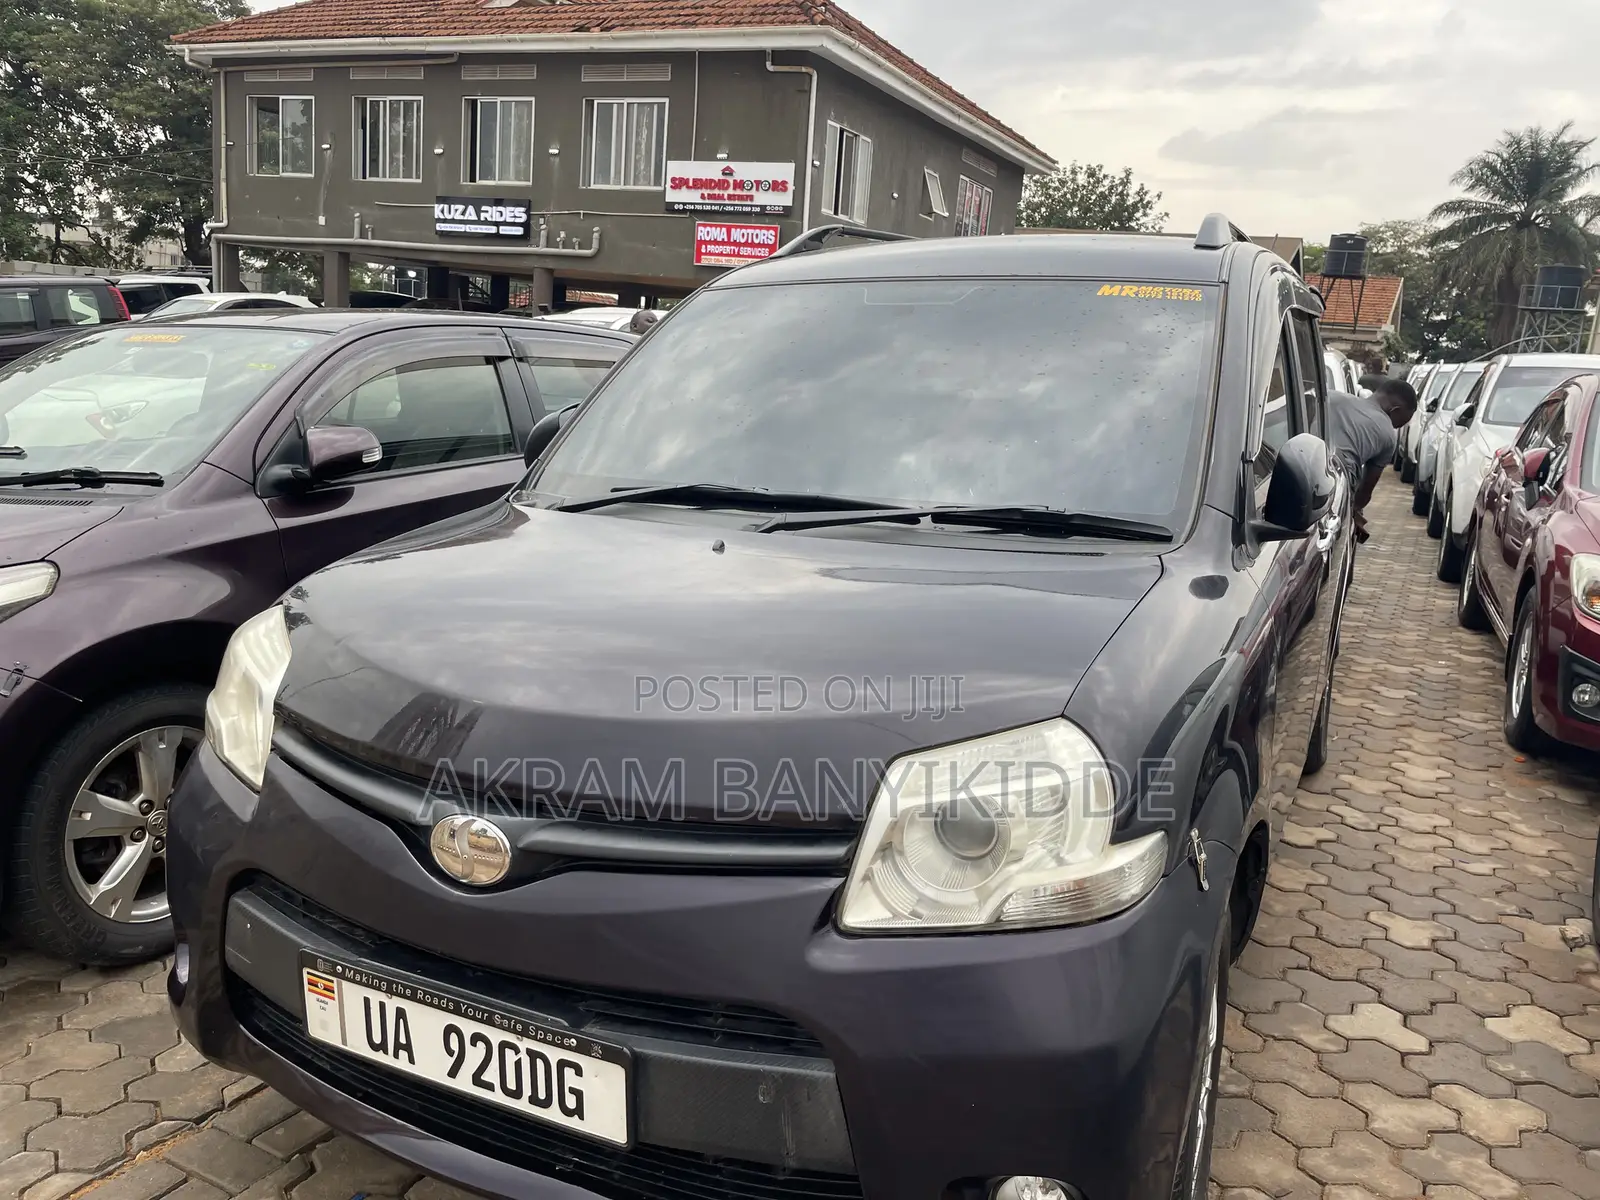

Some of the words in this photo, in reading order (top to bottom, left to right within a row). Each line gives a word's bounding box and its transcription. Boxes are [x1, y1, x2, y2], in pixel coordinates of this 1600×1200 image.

[670, 177, 730, 191] SPLENDID
[733, 179, 788, 193] MOTORS
[434, 203, 478, 220] KUZA
[480, 205, 528, 223] RIDES
[697, 226, 728, 242] ROMA
[730, 228, 775, 244] MOTORS
[701, 245, 706, 253] &
[706, 245, 739, 255] PROPERTY
[740, 247, 769, 256] SERVICES
[345, 968, 387, 992] Making
[392, 983, 412, 997] the
[417, 989, 455, 1010] Roads
[460, 1002, 489, 1021] Your
[493, 1013, 523, 1032] Safe
[528, 1025, 571, 1047] Space
[363, 996, 416, 1065] UA
[443, 1024, 585, 1121] 920DG
